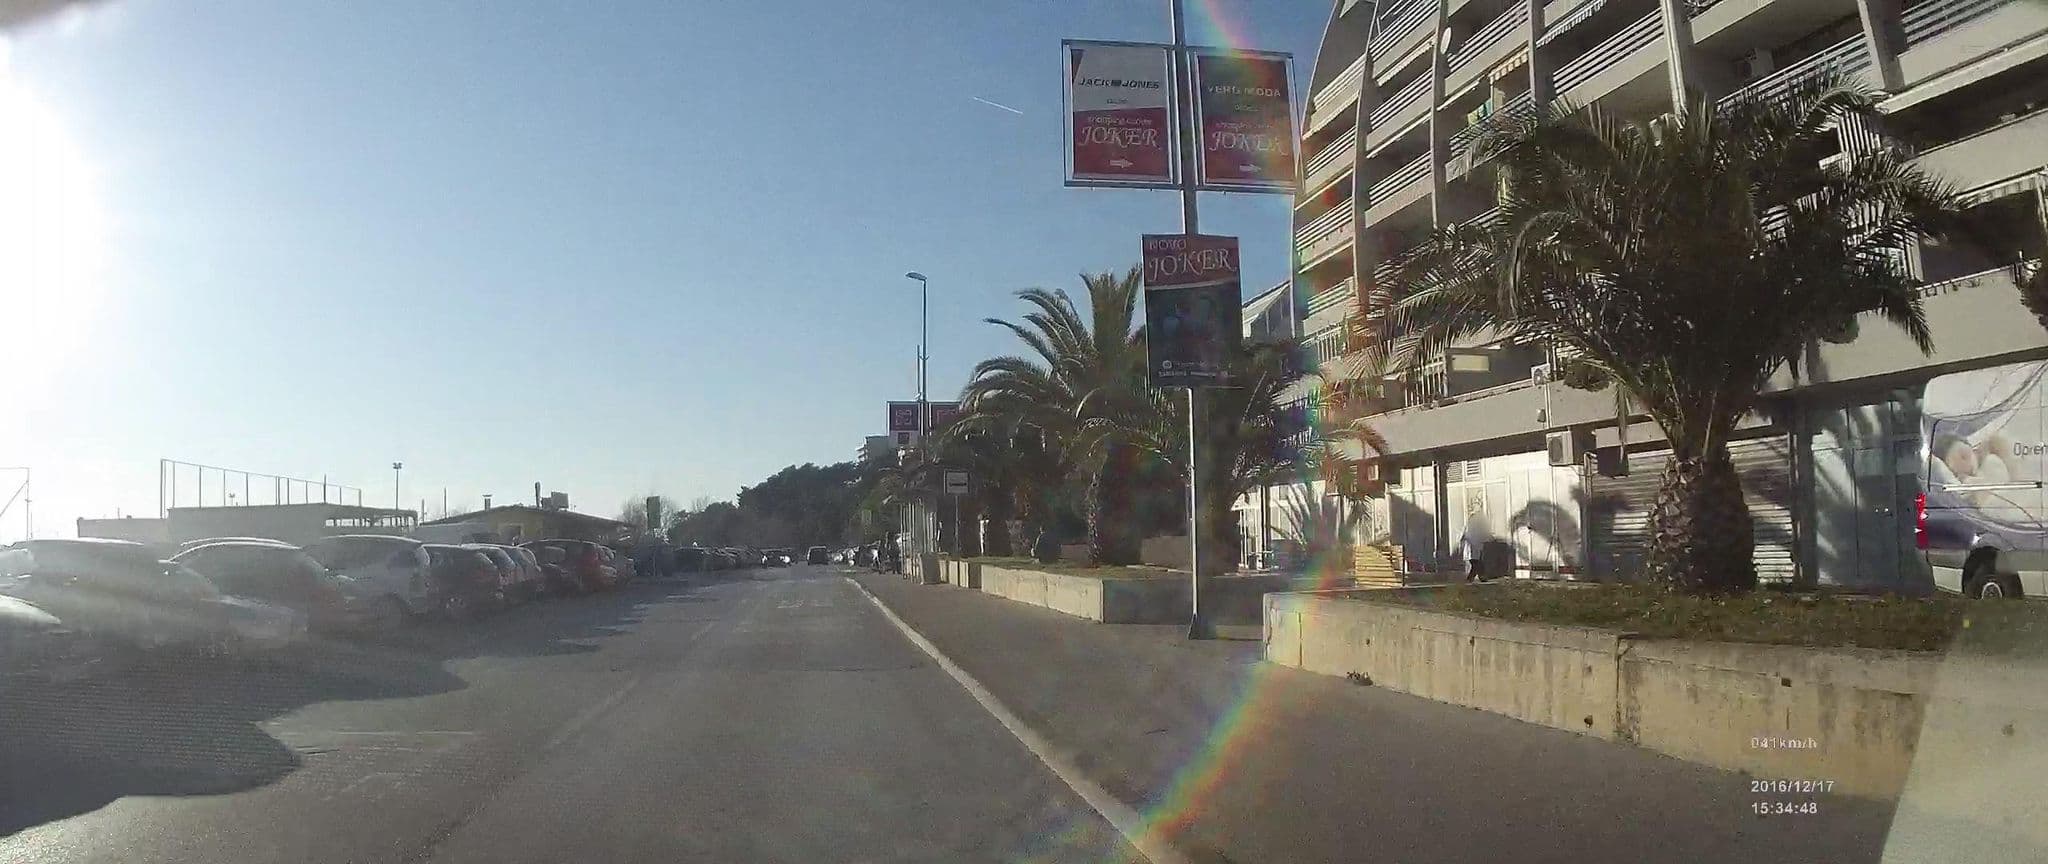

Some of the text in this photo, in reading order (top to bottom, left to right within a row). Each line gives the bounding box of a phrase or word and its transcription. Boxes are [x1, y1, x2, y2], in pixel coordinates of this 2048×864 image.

[1078, 126, 1161, 150] JOKER
[1209, 131, 1289, 156] JOKER
[1149, 248, 1237, 281] JOKER
